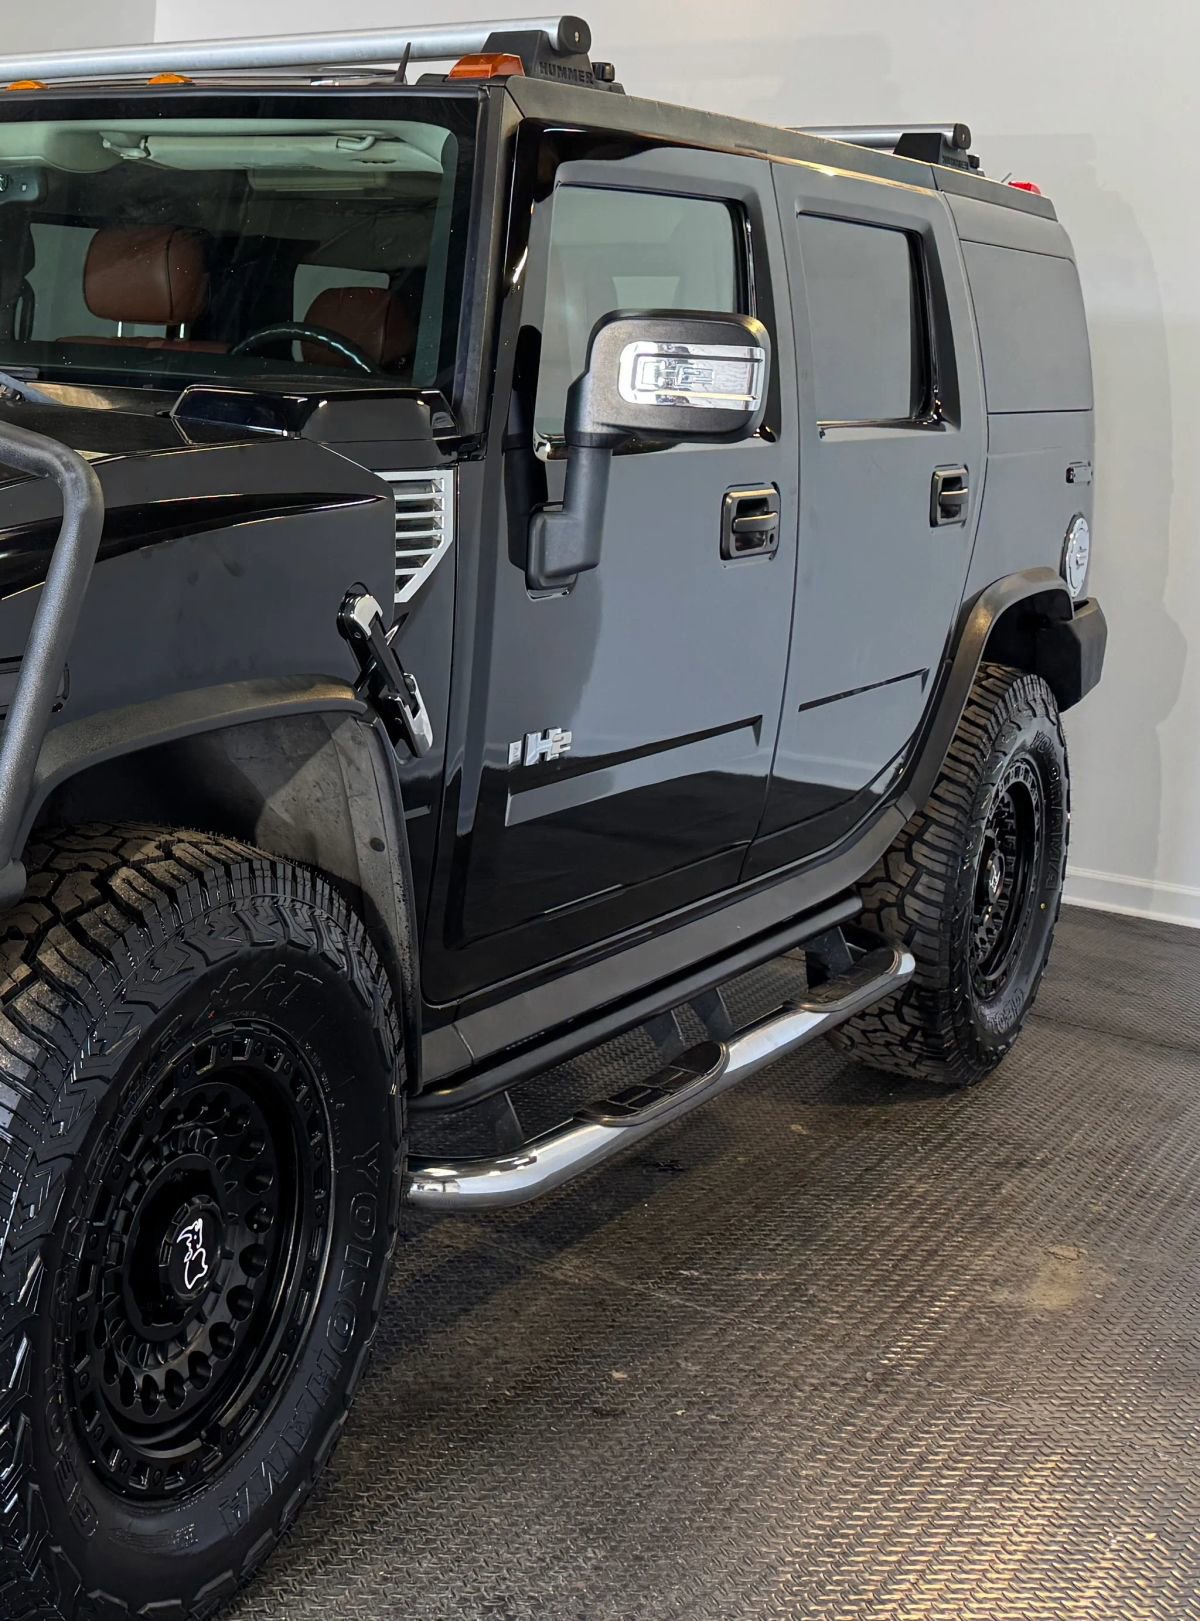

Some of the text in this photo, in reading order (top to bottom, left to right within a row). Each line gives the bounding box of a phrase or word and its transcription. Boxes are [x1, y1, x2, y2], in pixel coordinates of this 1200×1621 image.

[539, 62, 594, 85] HUMMER
[523, 727, 572, 767] H2
[218, 1142, 380, 1537] YOKOHAMA
